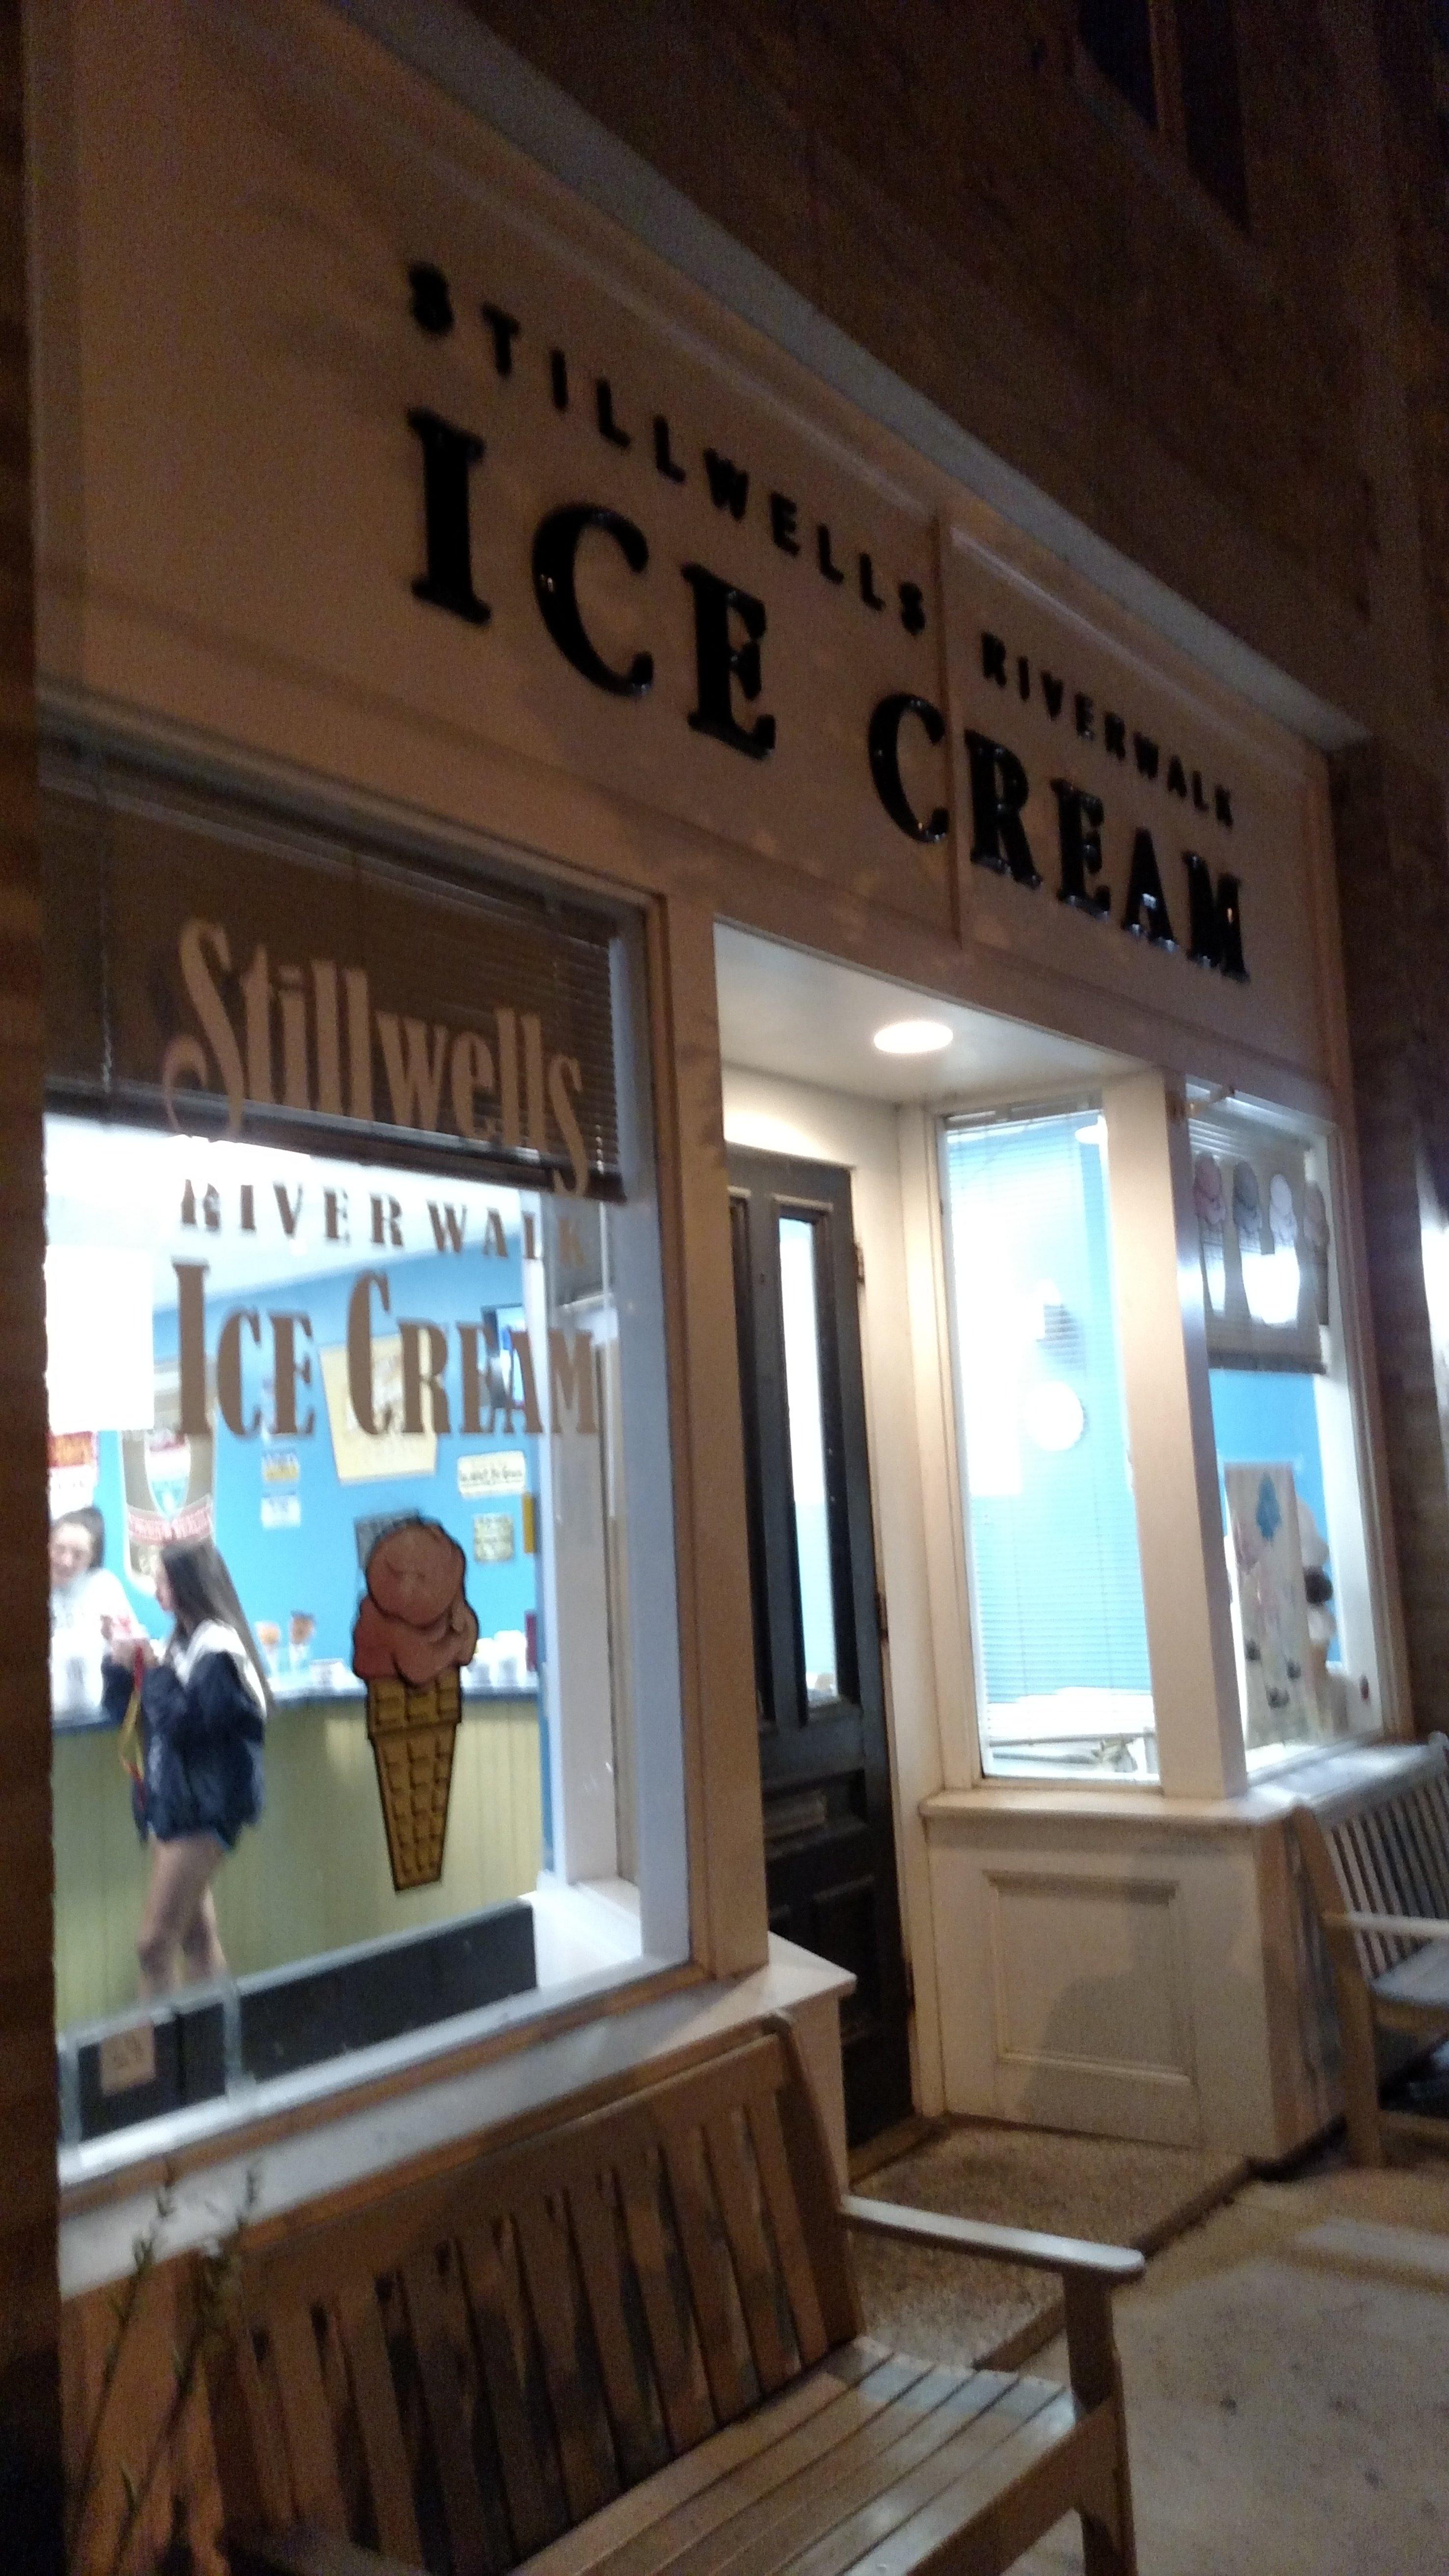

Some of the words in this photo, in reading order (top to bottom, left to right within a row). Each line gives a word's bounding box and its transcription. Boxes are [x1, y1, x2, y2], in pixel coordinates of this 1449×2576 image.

[407, 407, 776, 761] ICE
[868, 692, 1251, 982] CREAM
[408, 262, 926, 635] STILLWELLS
[982, 632, 1234, 827] RIVERWALK
[163, 917, 590, 1198] Stillwells
[171, 1255, 314, 1438] ICE
[347, 1268, 600, 1435] CREAM
